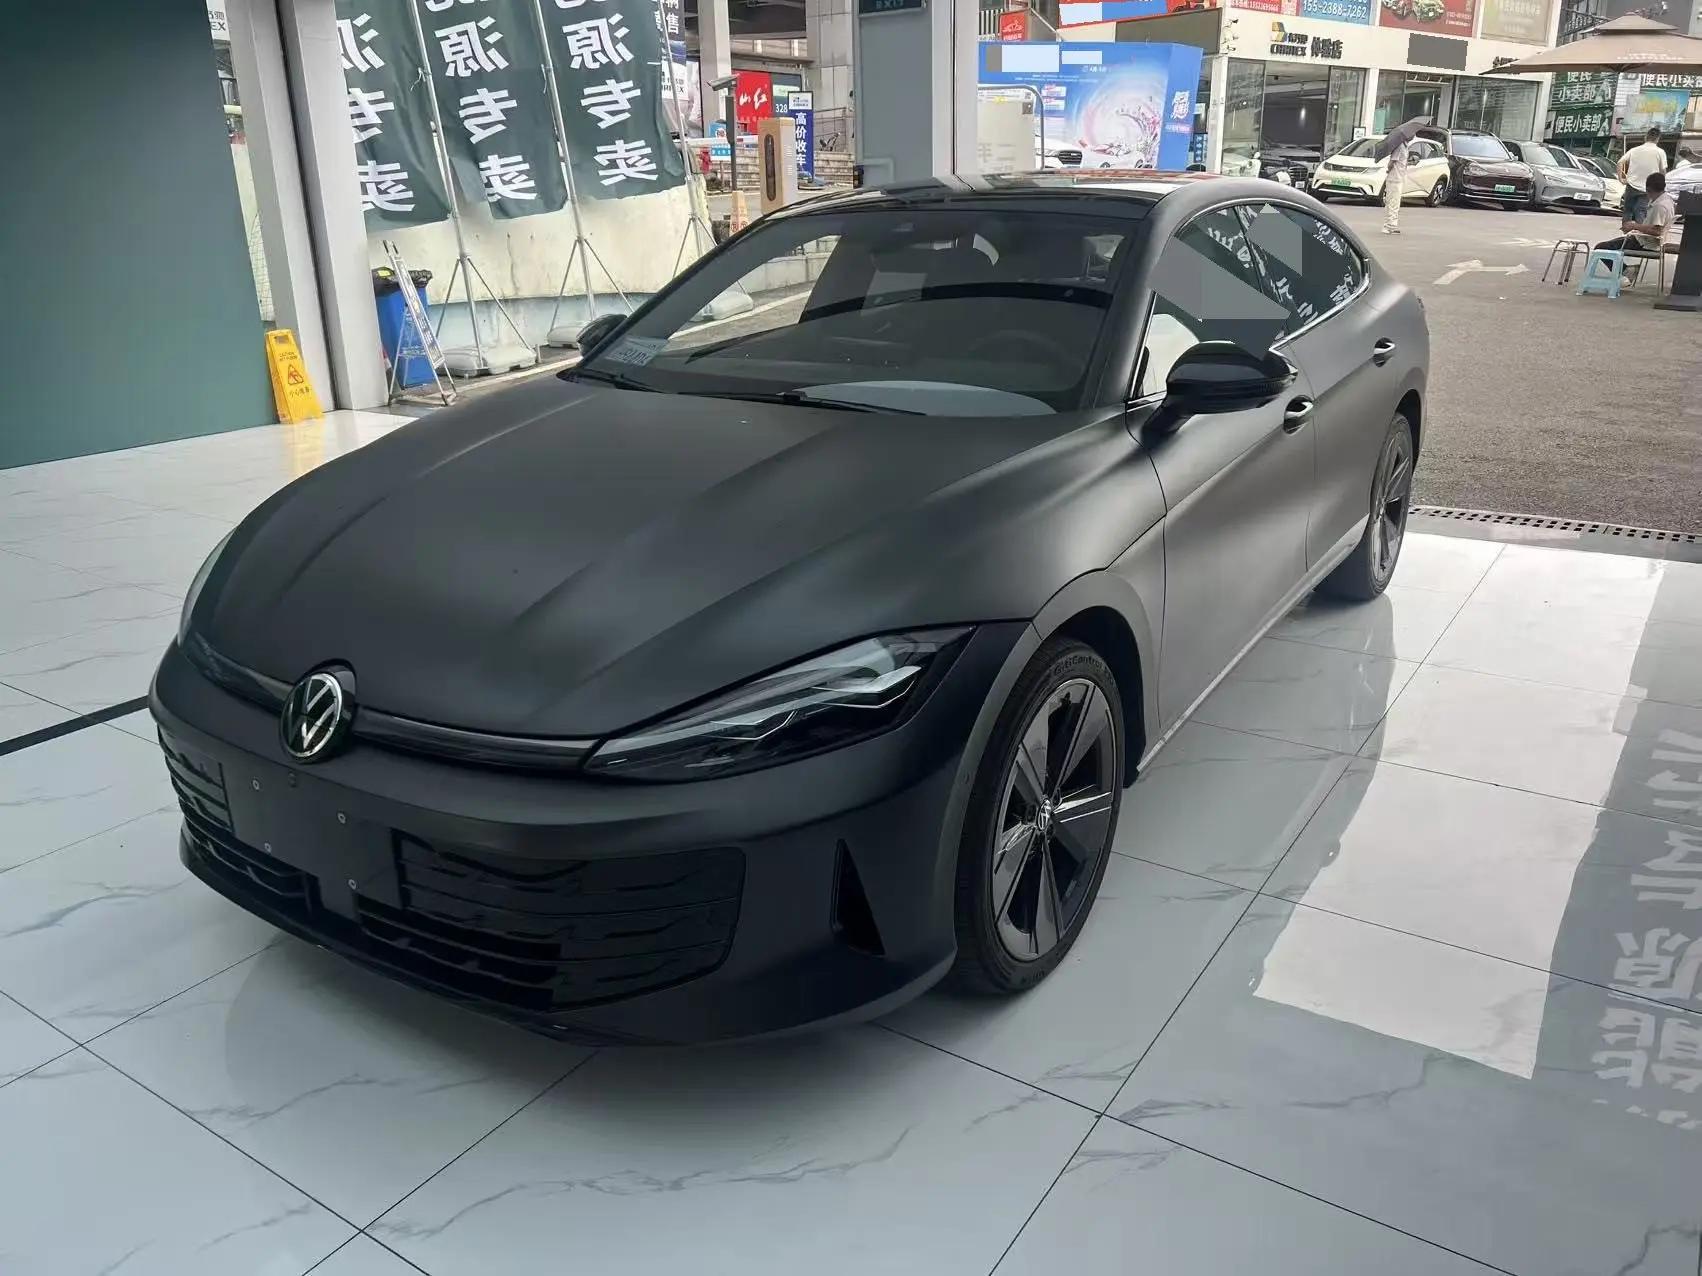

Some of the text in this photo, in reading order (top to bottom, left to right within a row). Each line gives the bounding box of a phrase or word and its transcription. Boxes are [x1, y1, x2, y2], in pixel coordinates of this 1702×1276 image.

[1303, 2, 1367, 20] 155-2388-7262
[1558, 83, 1597, 102] 小卖部
[775, 103, 788, 113] 328
[1555, 114, 1602, 134] 便民小卖部
[795, 112, 807, 166] 高价收车
